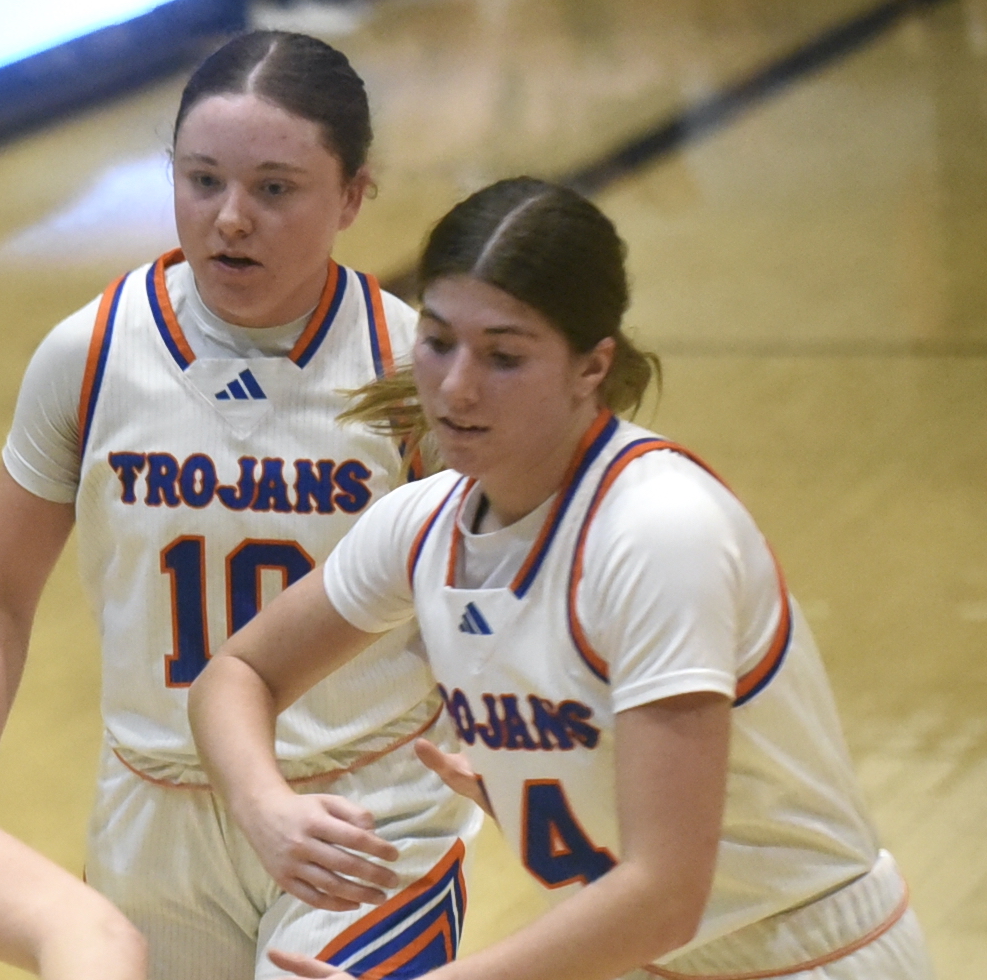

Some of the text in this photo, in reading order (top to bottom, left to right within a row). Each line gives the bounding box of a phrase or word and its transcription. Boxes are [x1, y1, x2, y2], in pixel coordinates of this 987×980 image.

[108, 451, 372, 515] TROJANS
[160, 535, 315, 688] 10
[437, 682, 601, 751] OJANS
[476, 774, 619, 889] 4
